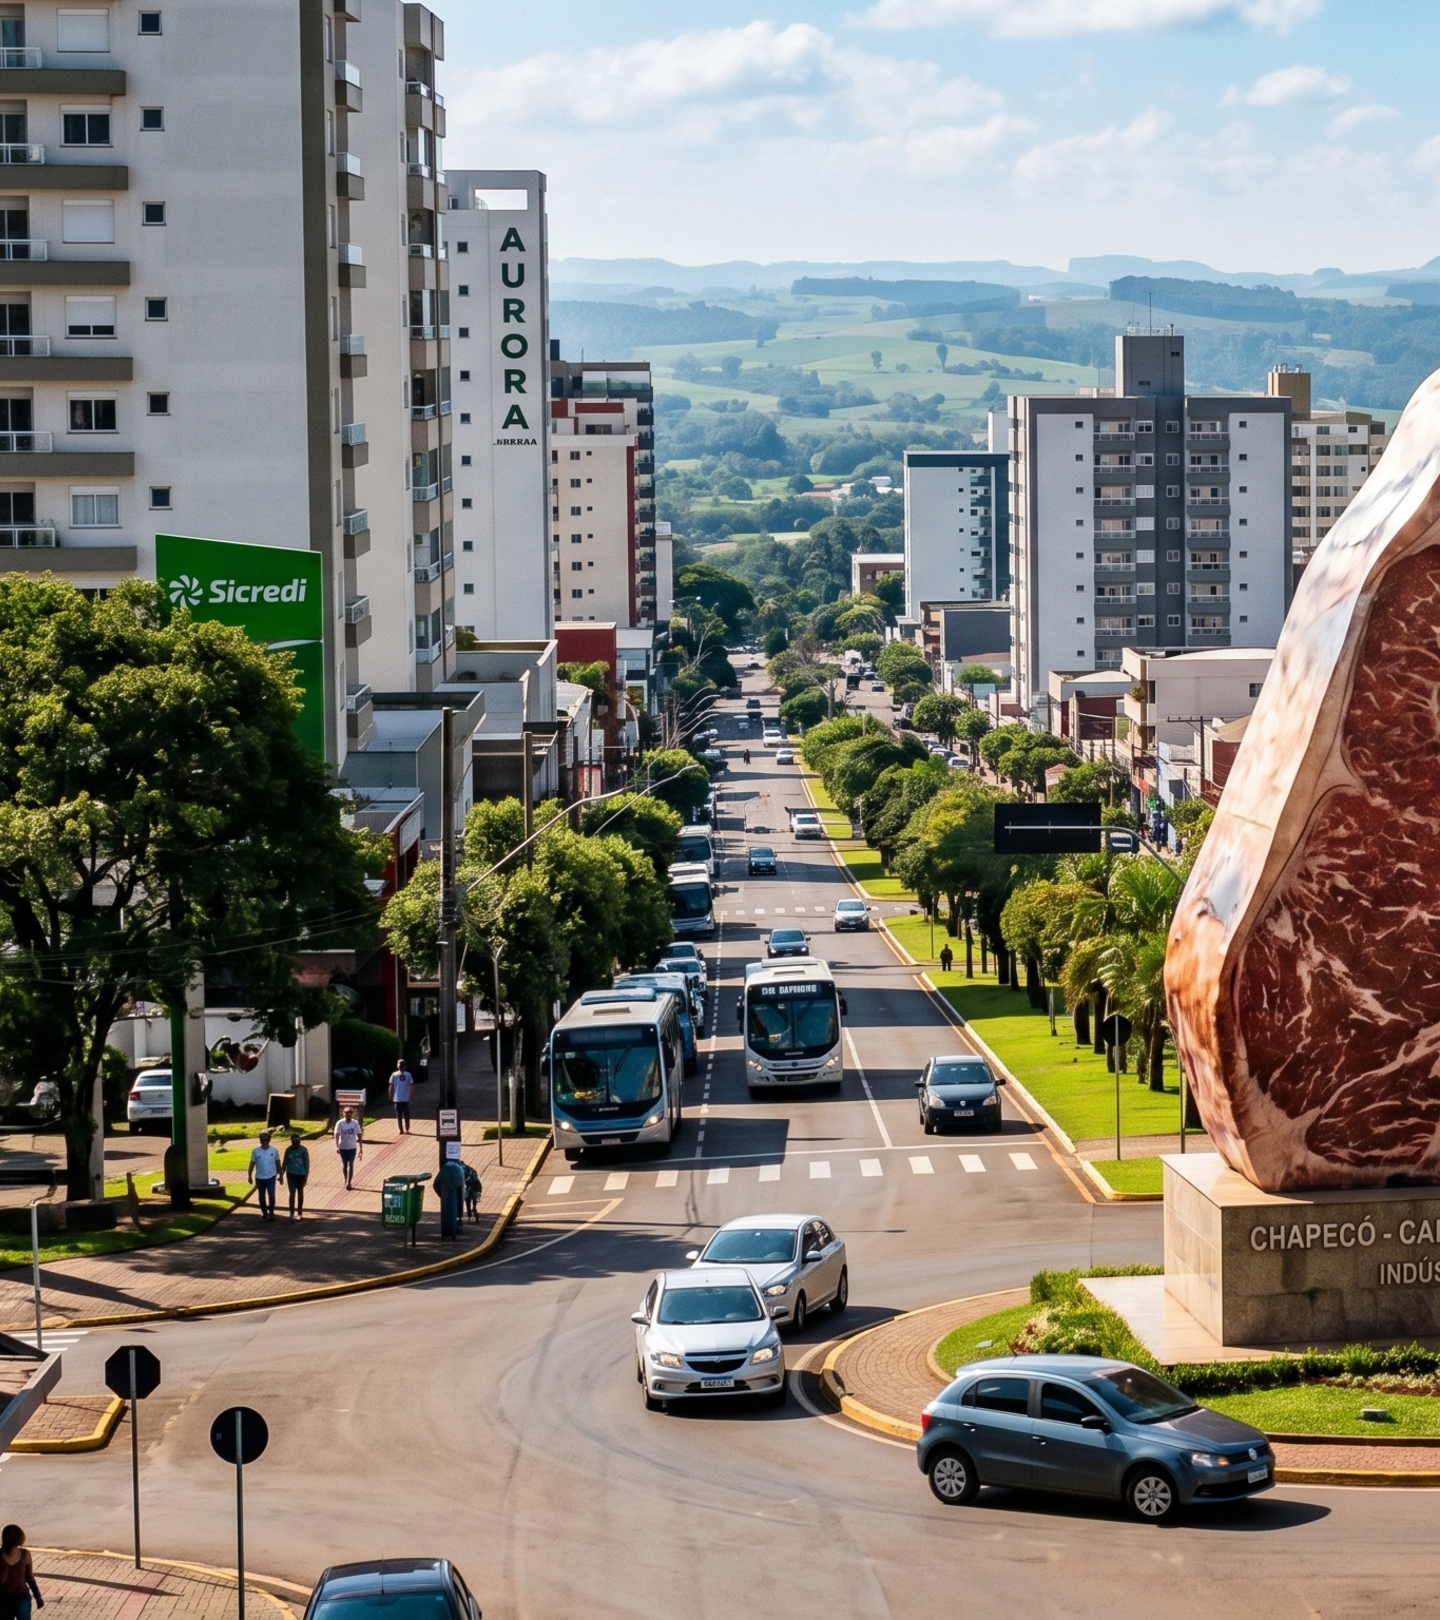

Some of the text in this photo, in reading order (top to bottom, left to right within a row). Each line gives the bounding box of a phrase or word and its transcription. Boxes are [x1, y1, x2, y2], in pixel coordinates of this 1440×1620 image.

[499, 227, 529, 429] AURORA
[208, 578, 307, 603] Sicredi
[1250, 1214, 1376, 1251] CHAPECÓ
